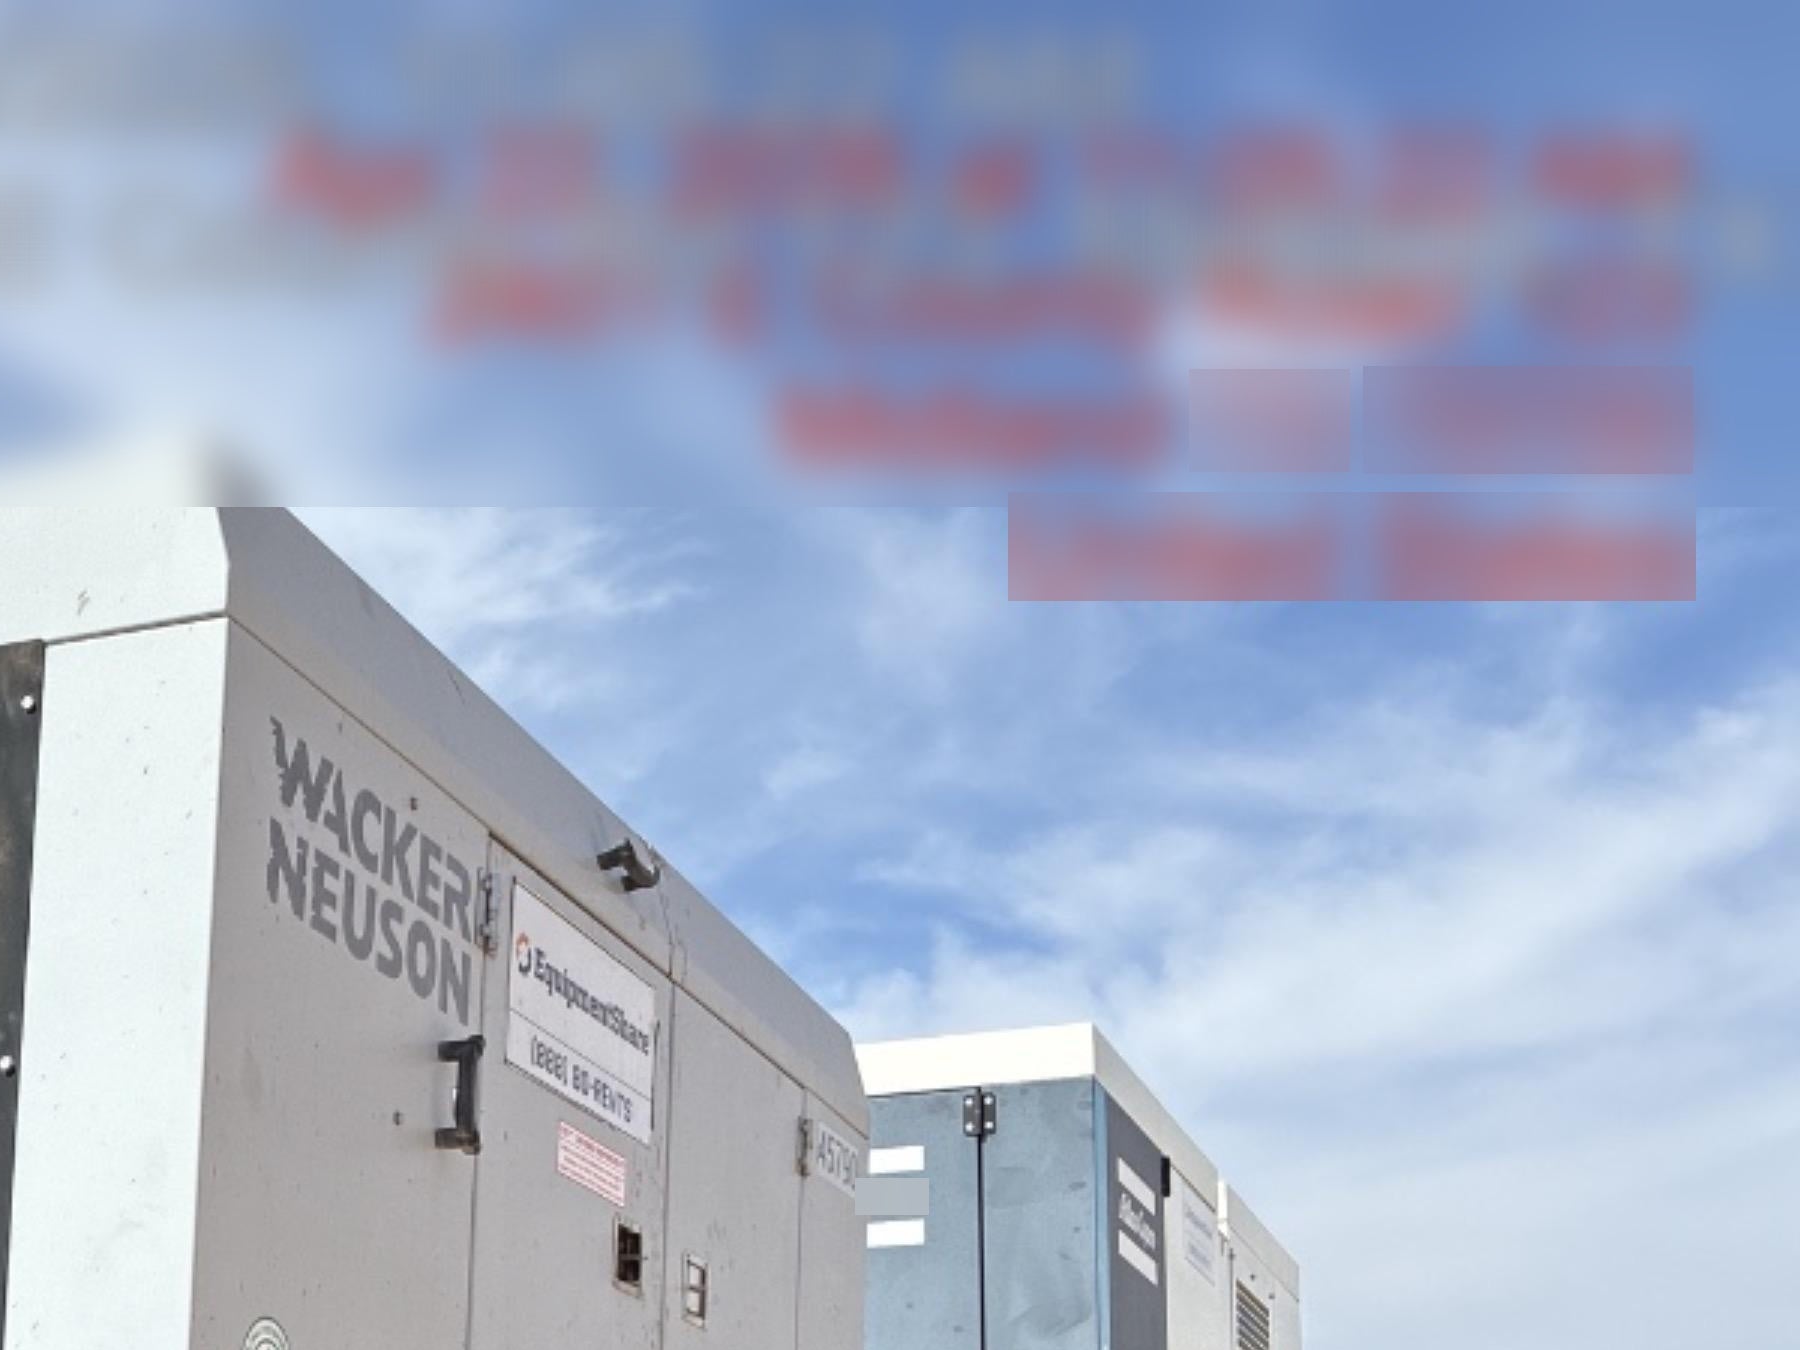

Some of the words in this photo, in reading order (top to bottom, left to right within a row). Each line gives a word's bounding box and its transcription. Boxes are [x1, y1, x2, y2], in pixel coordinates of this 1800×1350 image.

[267, 816, 472, 1026] NEUSON
[270, 716, 472, 943] WACKER
[533, 947, 650, 1057] EquipmentShare
